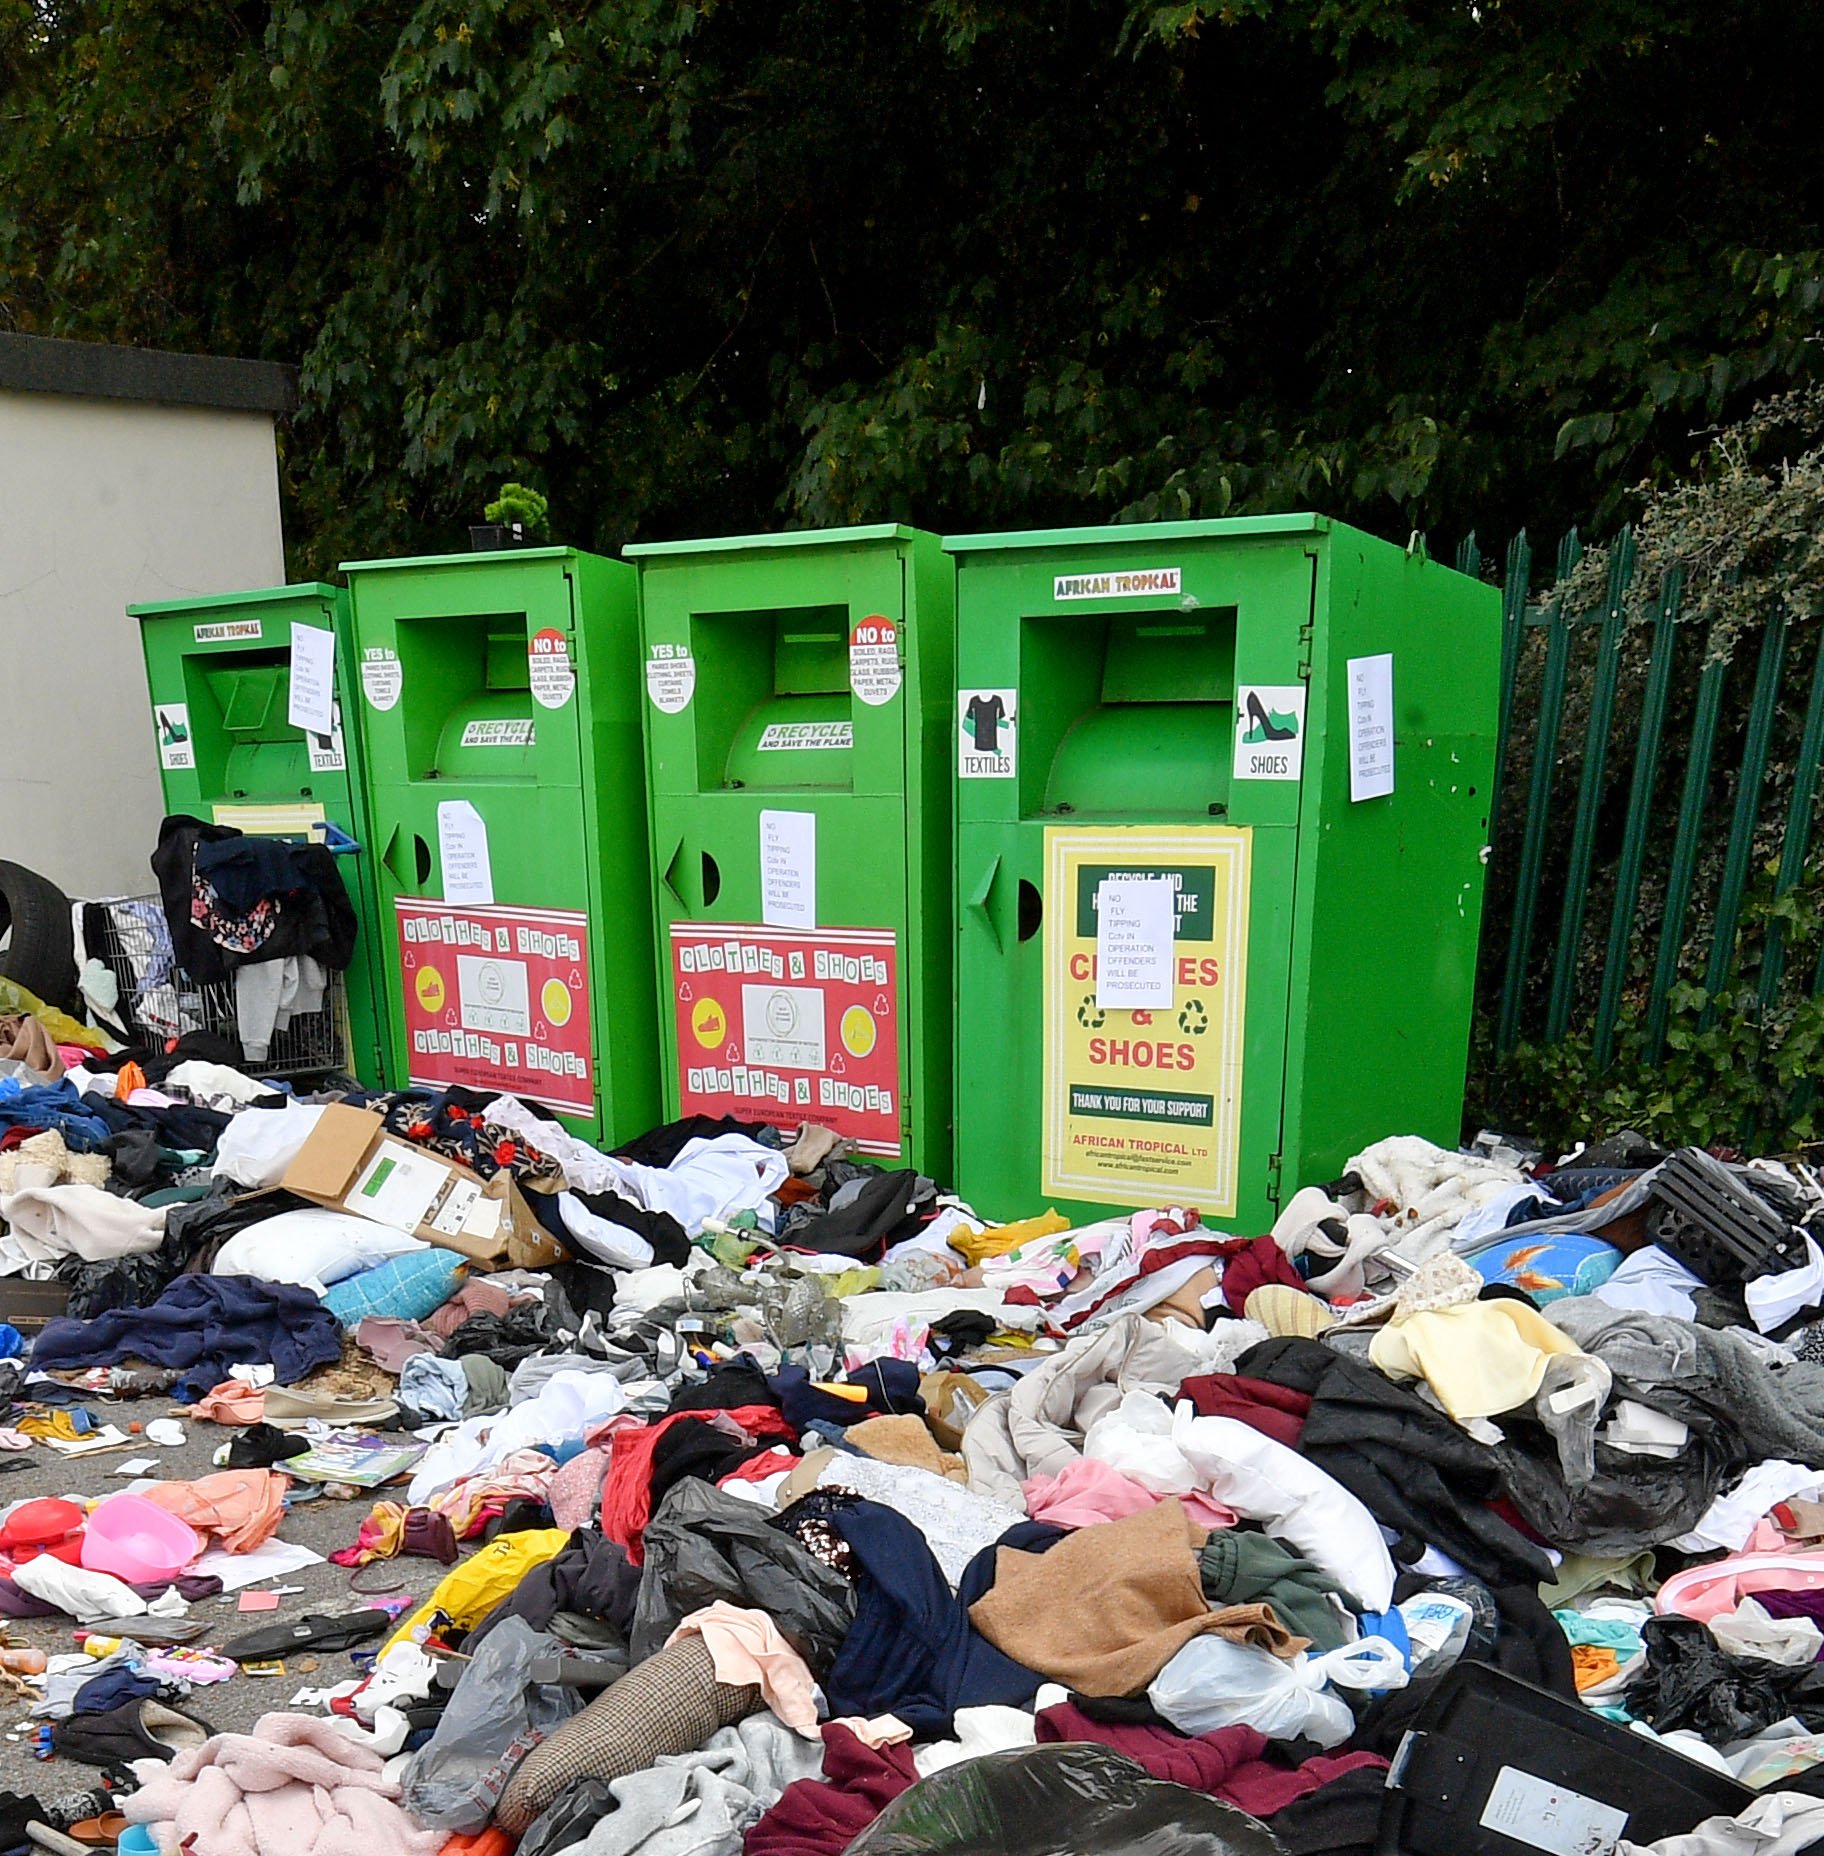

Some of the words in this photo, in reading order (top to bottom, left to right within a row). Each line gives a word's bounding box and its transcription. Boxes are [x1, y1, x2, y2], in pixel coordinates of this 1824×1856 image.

[1056, 576, 1111, 597] AFRICAN
[1115, 572, 1176, 593] TROPICAL
[856, 627, 878, 644] NO
[880, 627, 896, 643] to
[364, 648, 383, 661] YES
[385, 647, 395, 660] to
[533, 638, 552, 654] NO
[554, 638, 567, 653] to
[650, 644, 674, 659] YES
[676, 644, 688, 658] to
[777, 724, 852, 738] RECYCLE
[964, 756, 1010, 775] TEXTILES
[1250, 756, 1288, 775] SHOES
[1108, 894, 1121, 903] NO
[1176, 894, 1199, 912] THE
[1110, 907, 1125, 916] FLY
[1108, 919, 1141, 928] TIPPING
[405, 918, 491, 950] CLOTHES
[496, 930, 510, 950] &
[518, 928, 580, 960] SHOES
[1127, 932, 1135, 940] IN
[1107, 944, 1154, 953] OPERATION
[680, 943, 784, 978] CLOTHES
[789, 952, 805, 979] &
[814, 951, 887, 985] SHOES
[1107, 956, 1157, 965] OFFENDERS
[1106, 969, 1126, 977] WILL
[1127, 969, 1139, 977] BE
[1106, 981, 1161, 990] PROSECUTED
[415, 1031, 500, 1065] CLOTHES
[506, 1044, 518, 1066] &
[526, 1045, 586, 1078] SHOES
[1088, 1038, 1196, 1071] SHOES
[688, 1068, 790, 1104] CLOTHES
[795, 1079, 810, 1104] &
[820, 1078, 893, 1114] SHOES
[1072, 1092, 1102, 1110] THANK
[1103, 1095, 1122, 1111] YOU
[1123, 1097, 1140, 1113] FOR
[1141, 1098, 1165, 1115] YOUR
[1166, 1100, 1208, 1118] SUPPORT
[1072, 1134, 1124, 1149] AFRICAN
[1128, 1139, 1188, 1155] TROPICAL
[1192, 1148, 1208, 1157] LTD
[1097, 1161, 1179, 1175] www.africantropical.com
